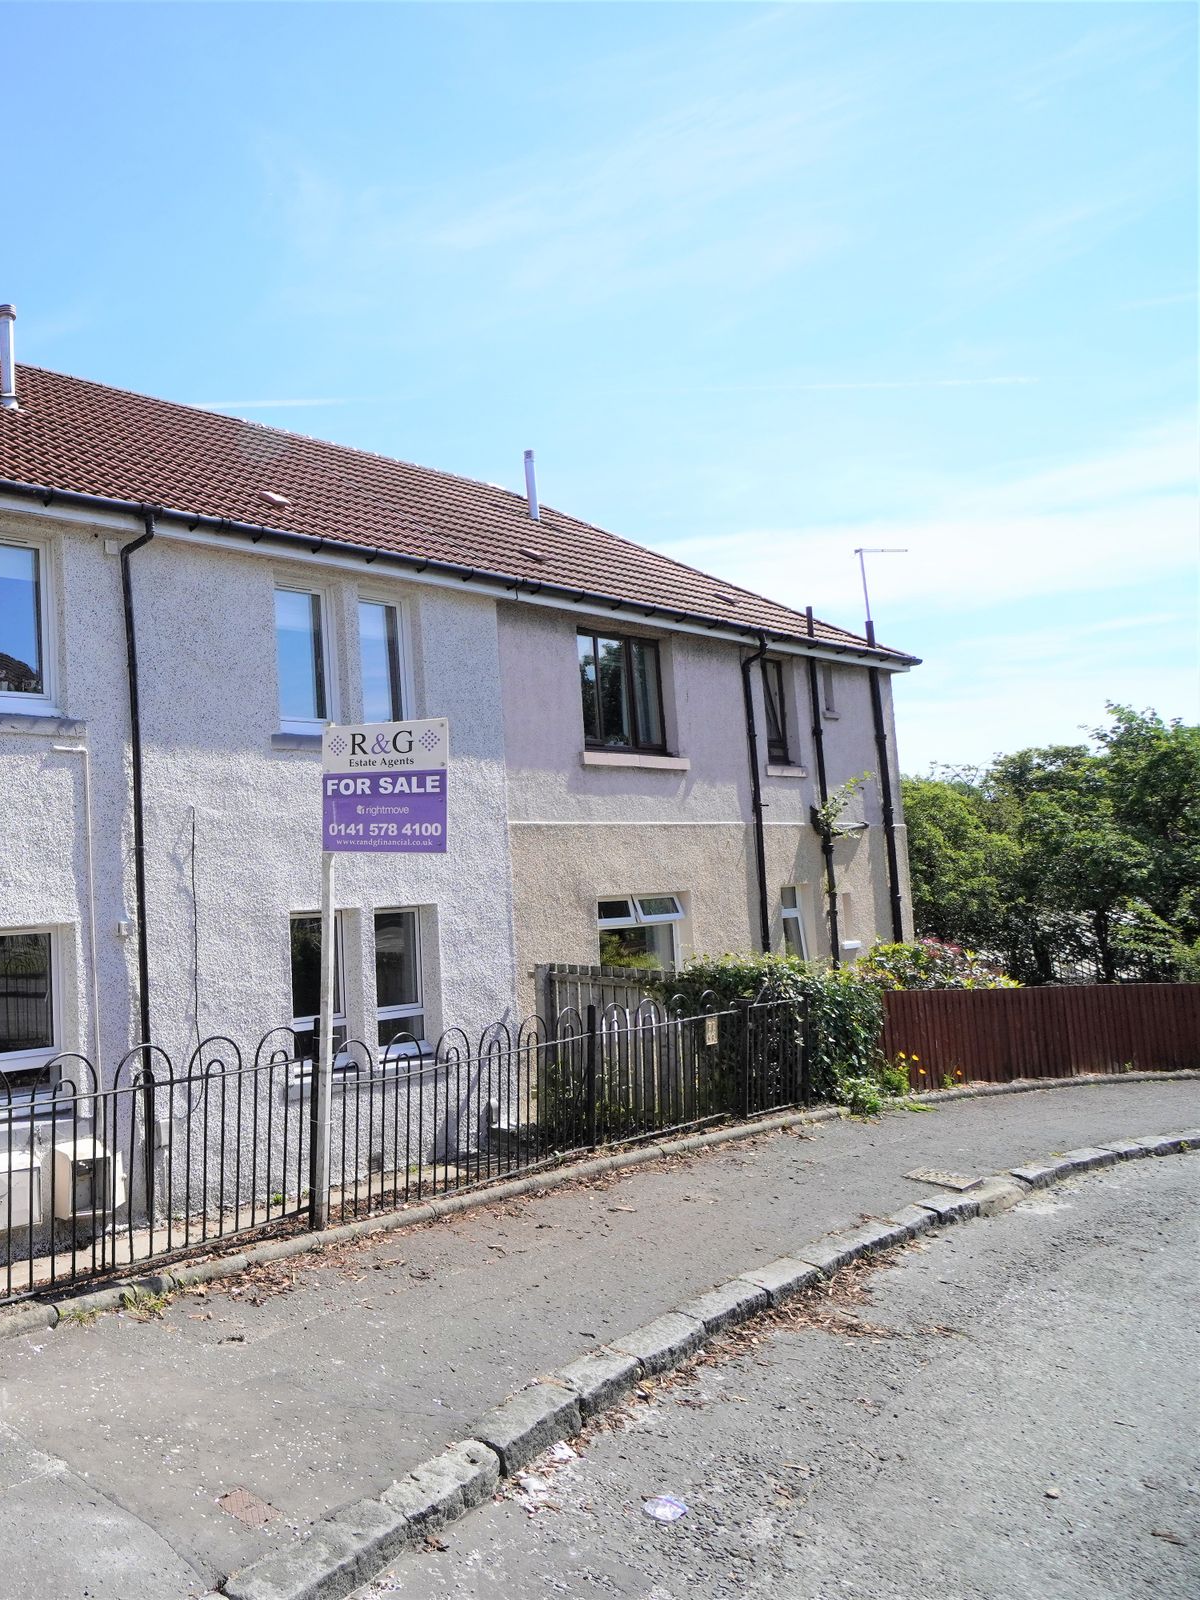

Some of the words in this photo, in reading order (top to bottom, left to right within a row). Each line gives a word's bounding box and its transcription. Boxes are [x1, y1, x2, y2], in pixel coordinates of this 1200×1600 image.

[350, 730, 414, 756] R&G
[349, 758, 377, 768] Estate
[380, 757, 415, 769] Agents
[326, 778, 372, 796] FOR
[378, 775, 441, 795] SALE
[366, 804, 410, 817] rightmove
[328, 823, 364, 836] 0141
[369, 823, 398, 836] 578
[401, 823, 442, 836] 4100
[336, 838, 433, 848] www.randgfinancial.co.uk
